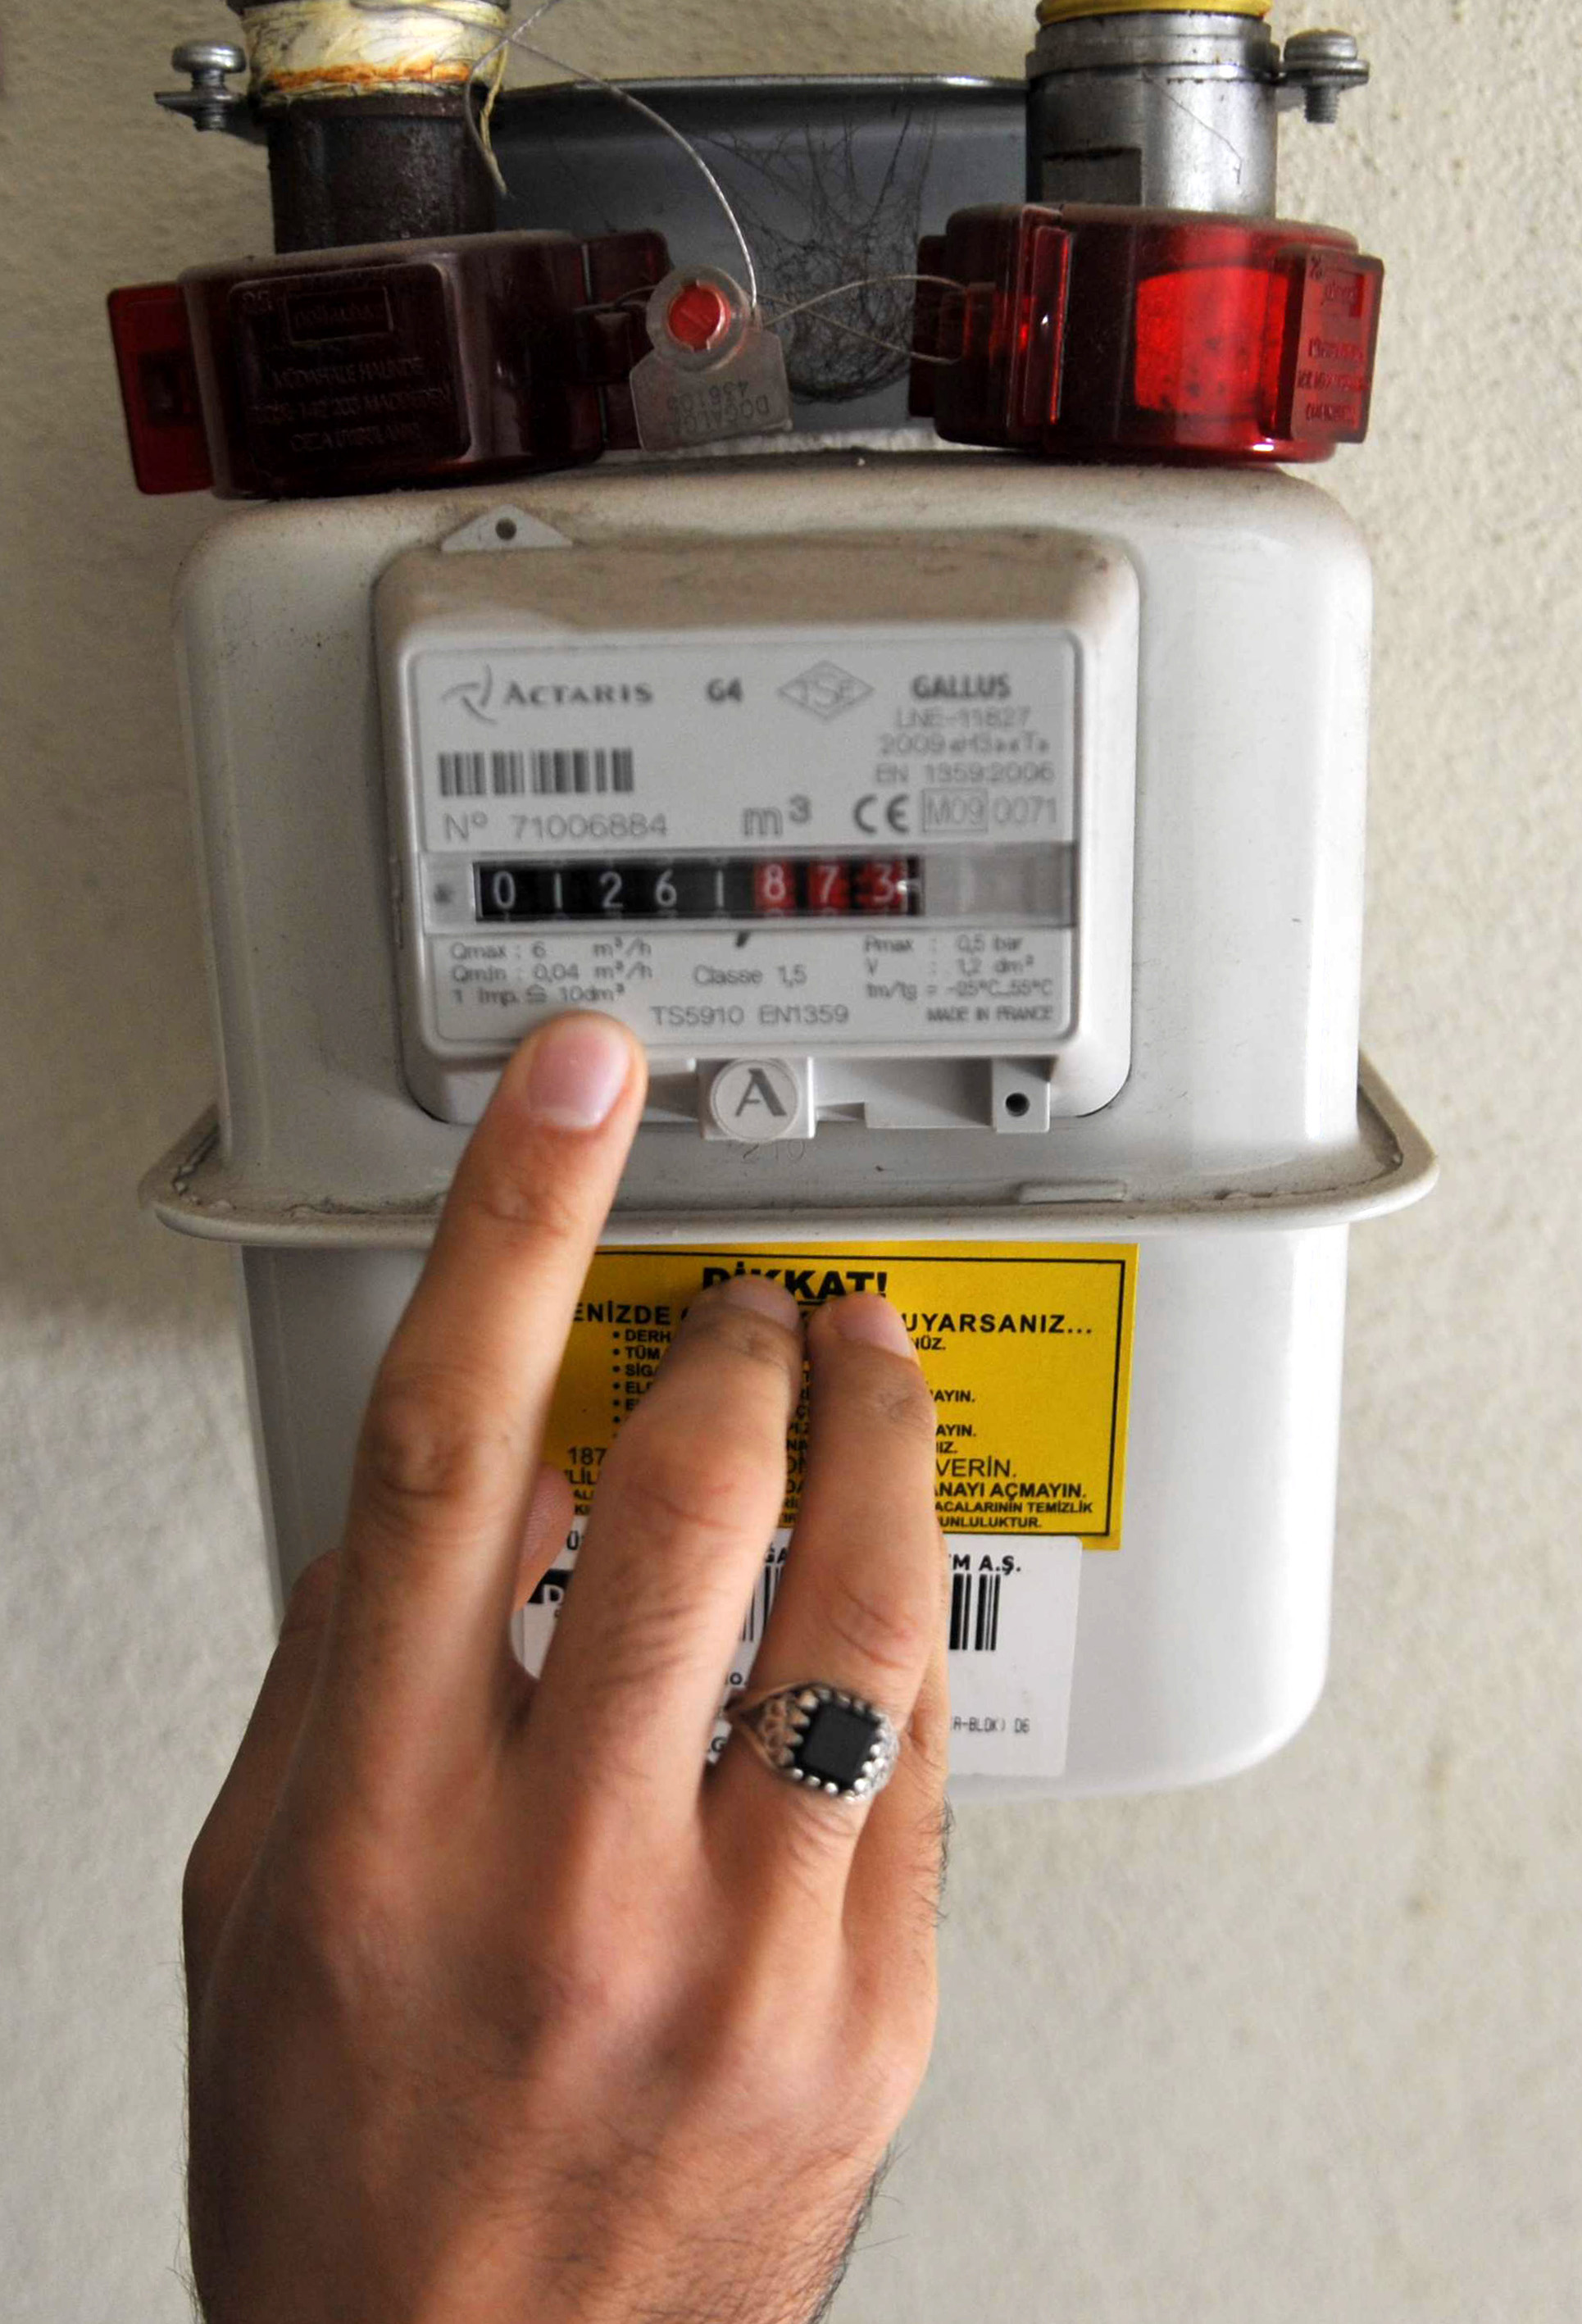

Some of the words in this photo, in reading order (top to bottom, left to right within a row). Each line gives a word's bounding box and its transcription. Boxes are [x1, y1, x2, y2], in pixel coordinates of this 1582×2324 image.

[503, 680, 653, 706] ACTARIS
[707, 678, 743, 703] G4
[911, 673, 1011, 700] GALLUS
[993, 795, 1057, 825] 0071
[511, 812, 668, 839] 71006884
[693, 963, 763, 985] Classe
[651, 1005, 745, 1026] TS5910
[758, 1003, 849, 1025] EN1359
[734, 1067, 787, 1117] A
[702, 1261, 888, 1300] DKAT!
[625, 1363, 660, 1377] SİG
[931, 1389, 975, 1403] AYIN.
[934, 1482, 984, 1497] NAYI
[990, 1482, 1087, 1501] AÇMAYIN.
[1027, 1499, 1093, 1514] TEMİZLİK
[979, 1554, 1022, 1576] A.Ş.
